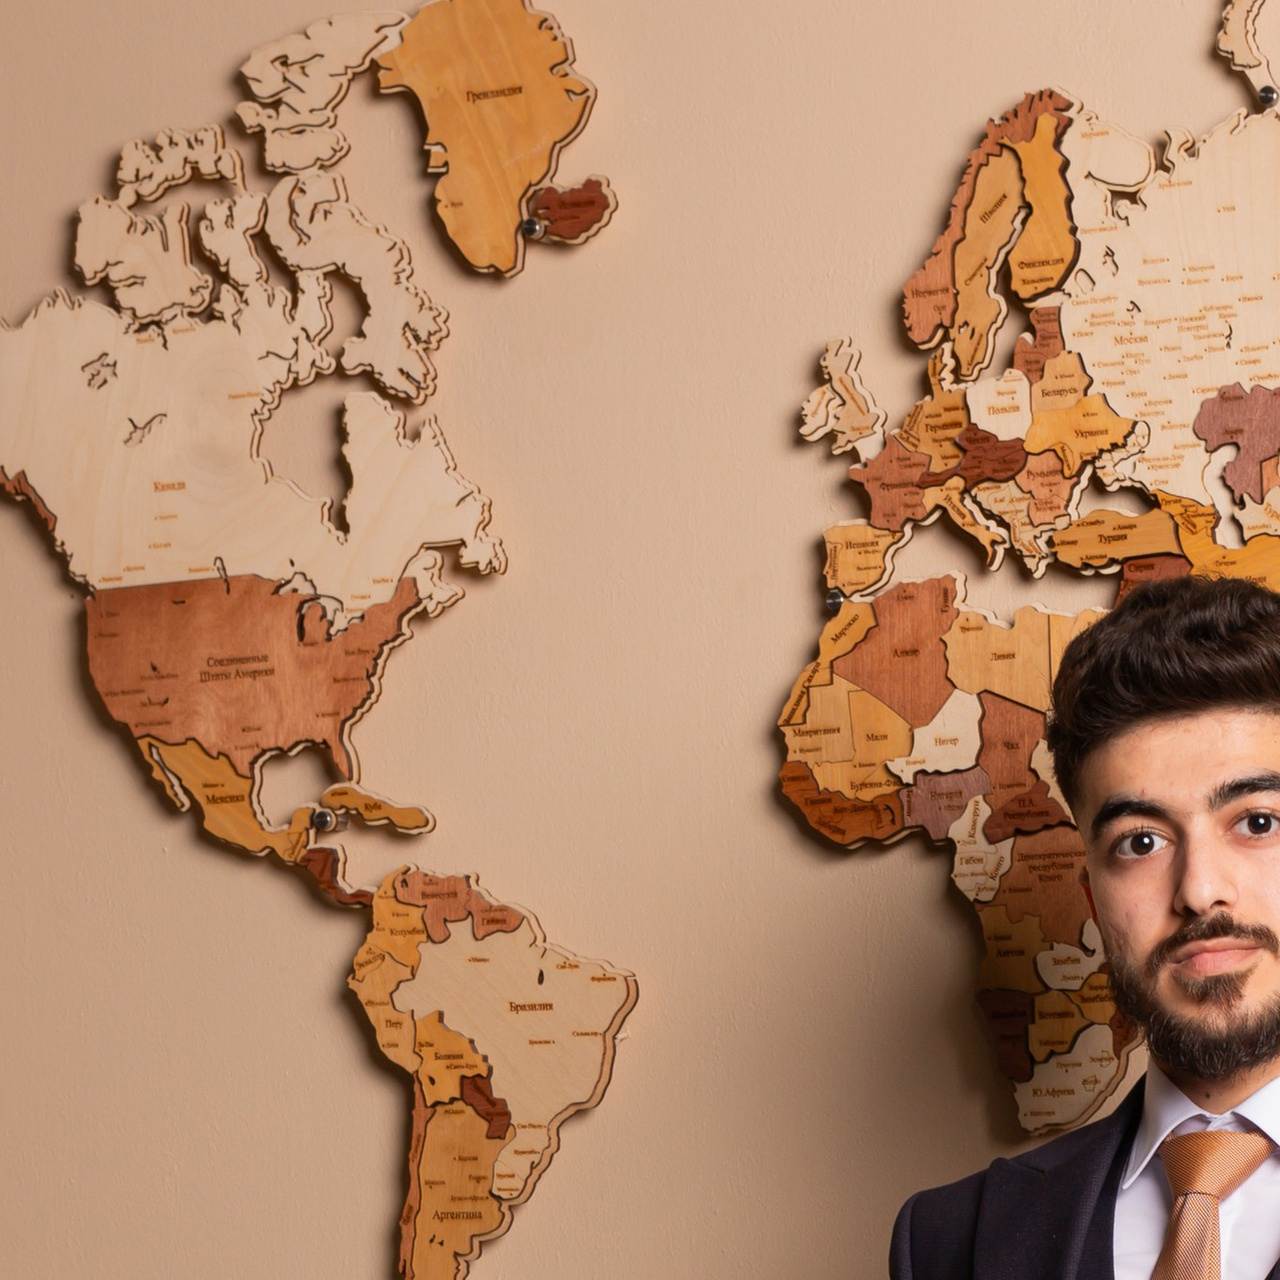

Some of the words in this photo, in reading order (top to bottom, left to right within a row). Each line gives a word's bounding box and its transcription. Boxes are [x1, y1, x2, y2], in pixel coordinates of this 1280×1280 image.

[466, 86, 523, 104] Гренландия
[1018, 257, 1065, 271] Финляндия
[1113, 334, 1149, 347] Москва
[1041, 386, 1078, 398] Беларусь
[987, 404, 1020, 416] Польша
[924, 421, 963, 434] Германия
[1074, 428, 1109, 439] Украина
[153, 480, 186, 493] Канада
[1098, 533, 1128, 544] Турция
[845, 540, 880, 550] Испания
[830, 613, 860, 644] Марокко
[206, 653, 270, 668] Соединенные
[990, 651, 1016, 662] Ливия
[199, 670, 232, 683] Штаты
[233, 665, 276, 683] Америки
[792, 726, 841, 738] Мавритания
[866, 733, 888, 742] Мали
[934, 737, 959, 748] Нигер
[205, 793, 246, 806] Мексика
[959, 856, 984, 866] Габон
[390, 926, 425, 937] Колумбия
[1051, 956, 1081, 966] Замбия
[509, 1001, 554, 1014] Бразилия
[385, 1019, 404, 1030] Перу
[432, 1209, 483, 1221] Аргентина
